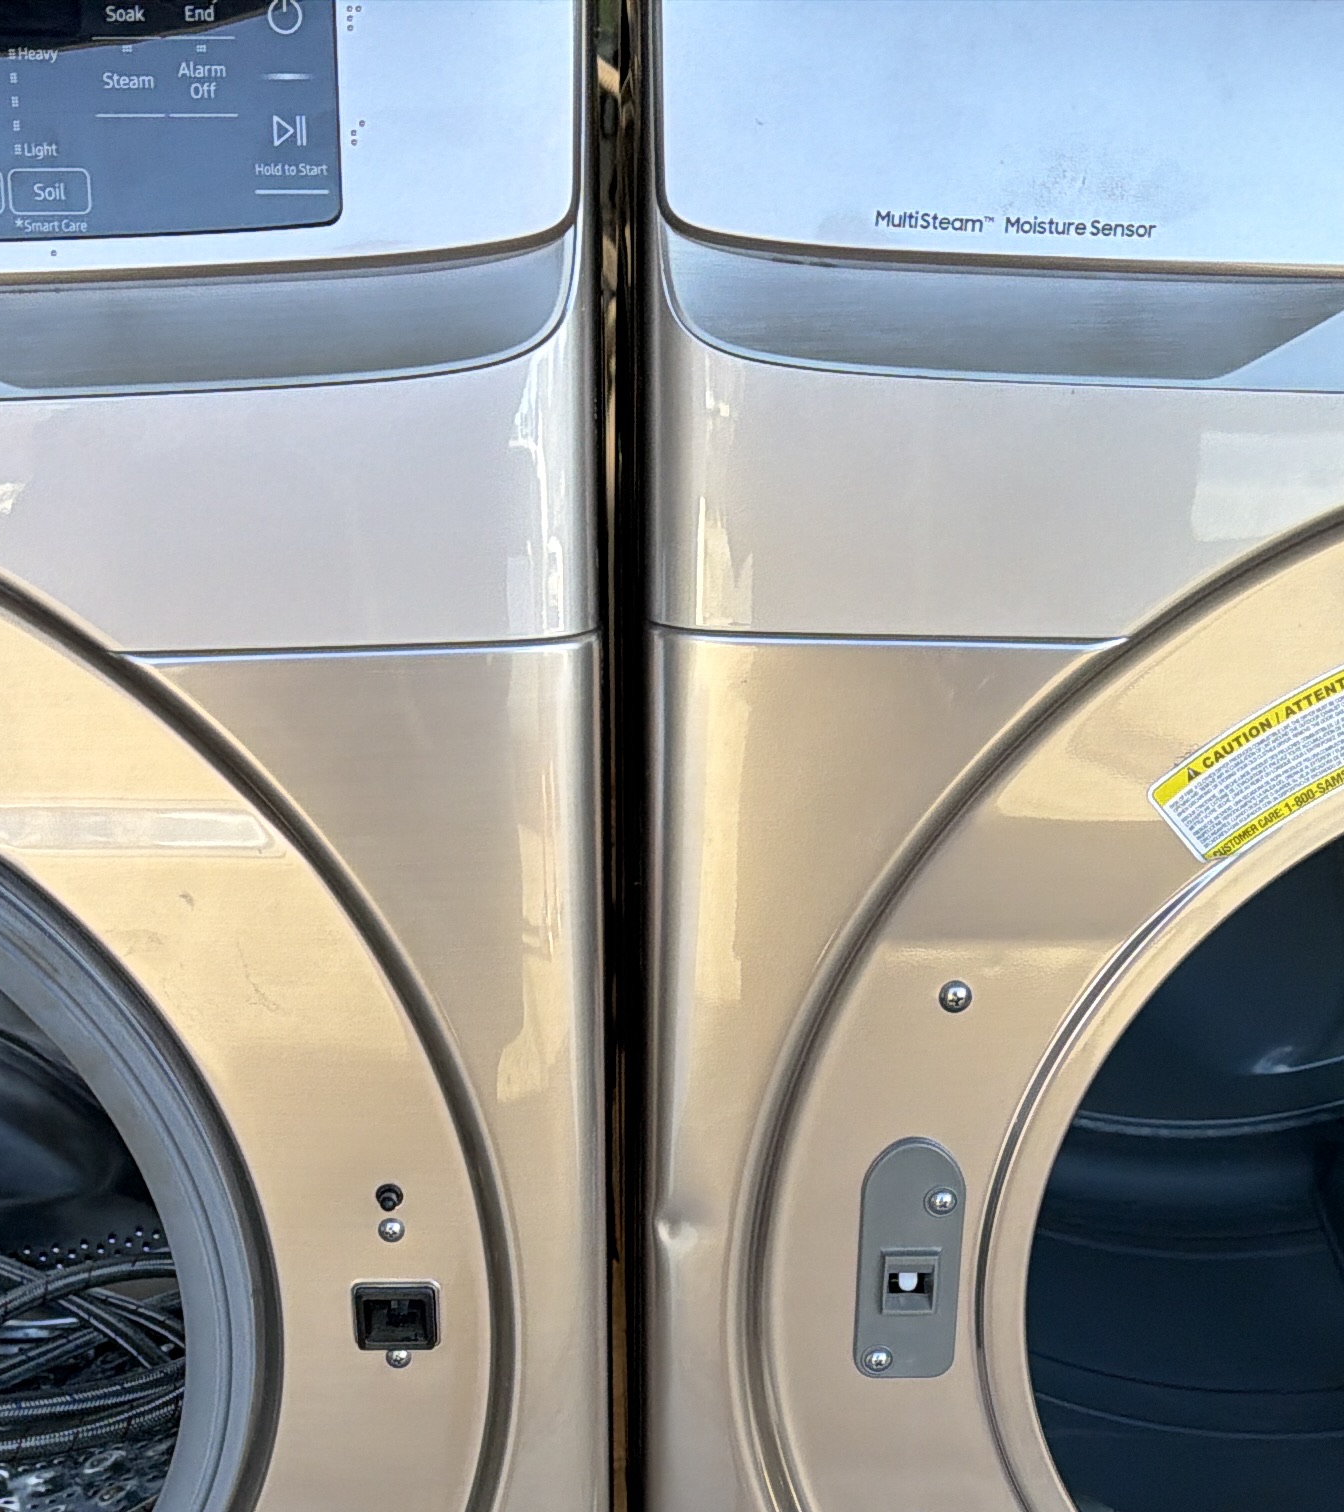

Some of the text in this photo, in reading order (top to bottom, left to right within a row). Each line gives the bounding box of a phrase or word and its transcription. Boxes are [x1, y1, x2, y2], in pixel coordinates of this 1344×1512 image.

[105, 6, 145, 22] Soak
[184, 6, 215, 21] End
[18, 48, 58, 63] Heavy
[178, 62, 226, 78] Alarm
[103, 72, 154, 90] Steam
[190, 82, 216, 99] Off
[24, 143, 58, 158] Light
[256, 163, 328, 176] Hold to Start
[33, 183, 65, 201] Soil
[62, 220, 87, 232] Care
[1005, 216, 1086, 236] Moisture
[1090, 220, 1157, 238] Sensor
[1202, 721, 1271, 770] CAUTION
[1212, 820, 1258, 859] CUSTOMER
[1256, 807, 1284, 832] CARE:
